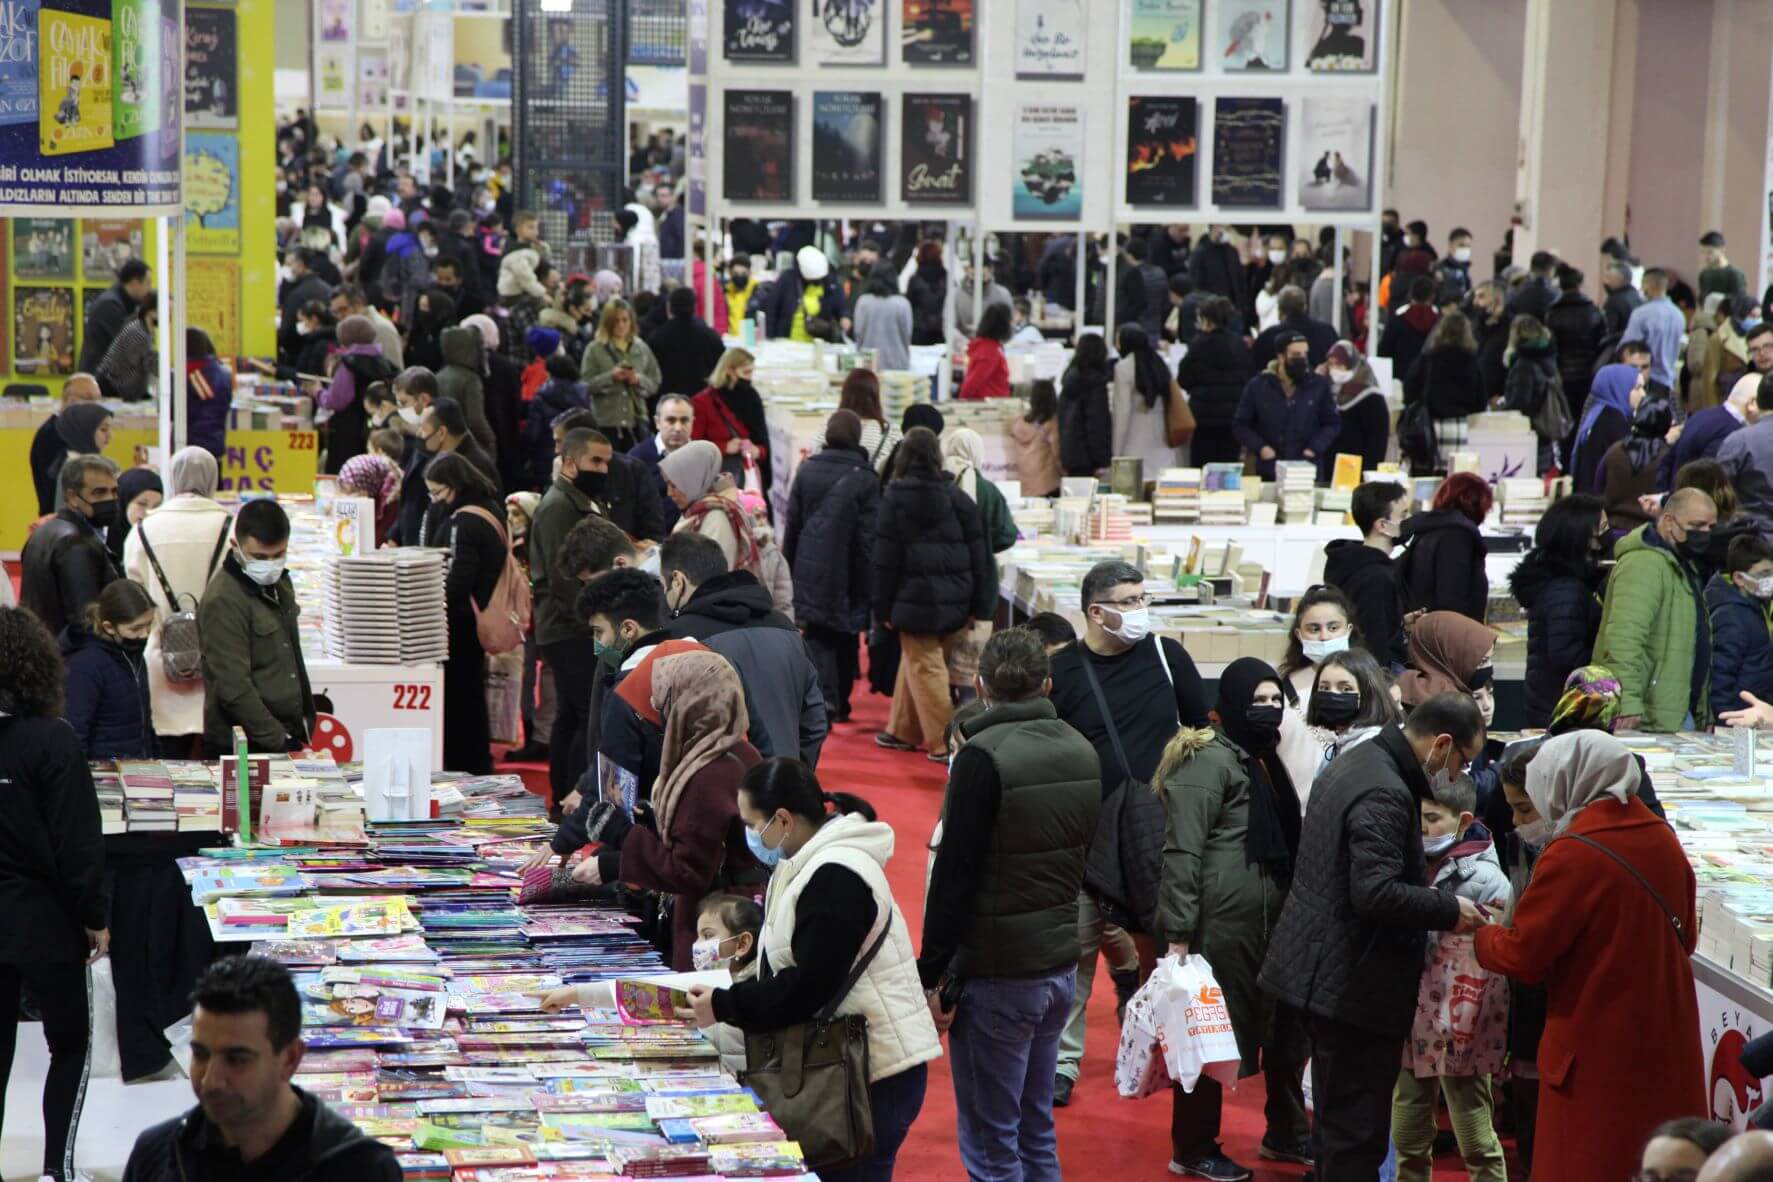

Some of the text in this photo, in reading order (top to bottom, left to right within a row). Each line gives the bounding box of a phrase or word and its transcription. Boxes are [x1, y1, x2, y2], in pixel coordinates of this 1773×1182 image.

[20, 168, 61, 183] OLMAK
[59, 190, 100, 203] ALTINDA
[289, 433, 315, 450] 223
[393, 684, 431, 710] 222
